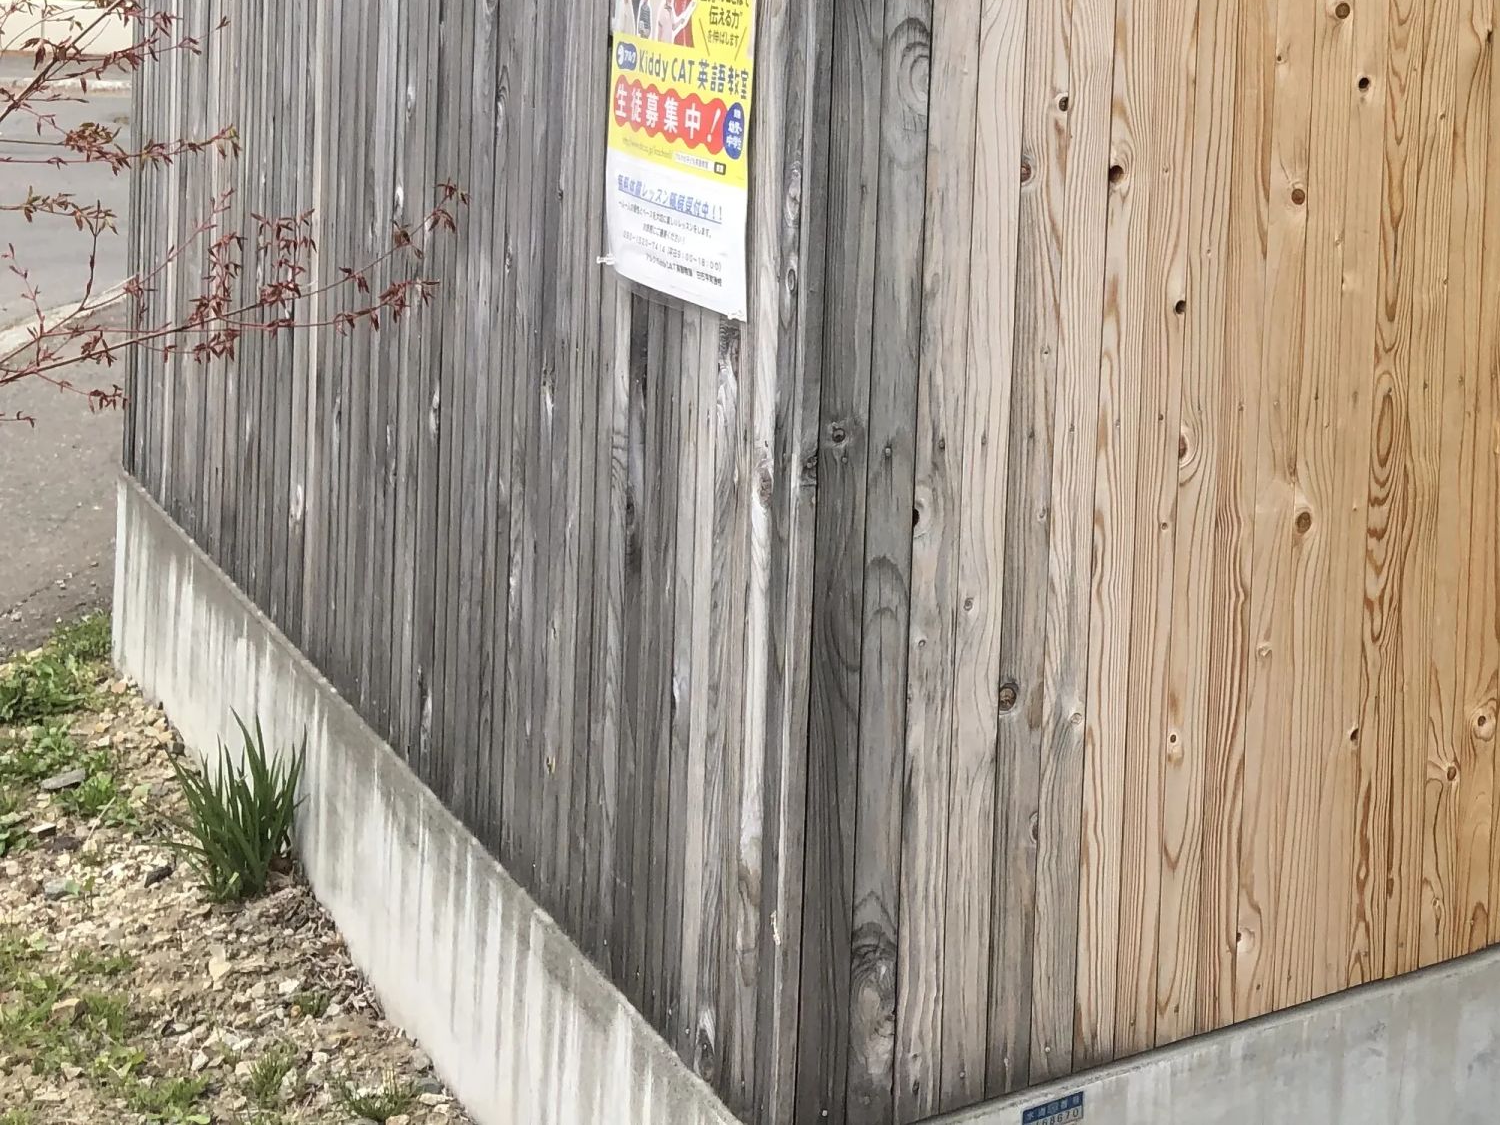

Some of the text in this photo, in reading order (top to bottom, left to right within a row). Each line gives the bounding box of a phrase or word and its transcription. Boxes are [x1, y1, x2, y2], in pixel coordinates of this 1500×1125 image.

[639, 49, 669, 83] Kiddy
[671, 57, 695, 85] CAT
[697, 58, 749, 100] 英語教室
